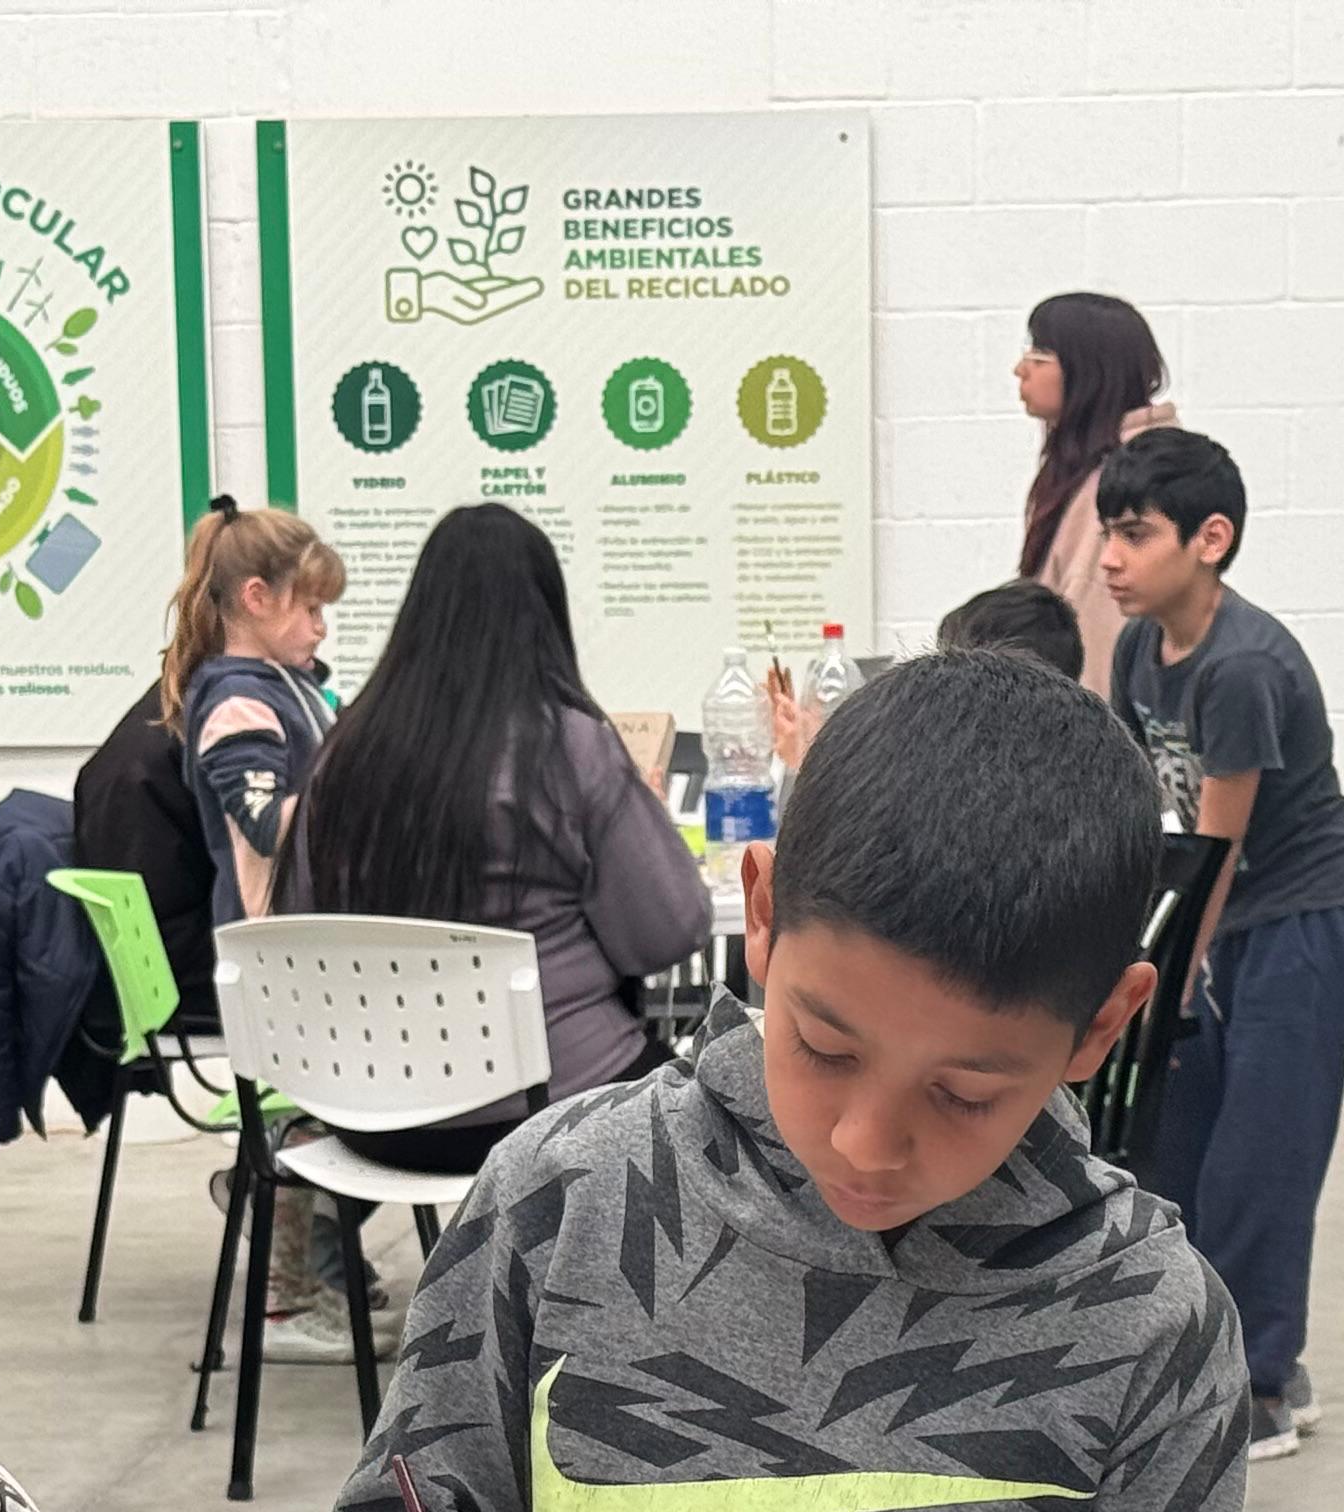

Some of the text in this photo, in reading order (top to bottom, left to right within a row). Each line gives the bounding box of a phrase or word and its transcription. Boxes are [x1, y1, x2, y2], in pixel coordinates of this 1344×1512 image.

[563, 187, 702, 211] GRANDES
[564, 216, 734, 240] BENEFICIOS
[564, 246, 763, 271] AMBIENTALES
[565, 275, 792, 300] DEL RECICLADO
[481, 466, 532, 481] PAPEL
[610, 473, 686, 487] ALUMINIO
[746, 469, 821, 485] PLÁSTICO
[353, 476, 406, 490] VIDRIO
[481, 480, 548, 497] CARTÓN
[0, 664, 64, 677] nuestros
[68, 663, 135, 677] residuos,
